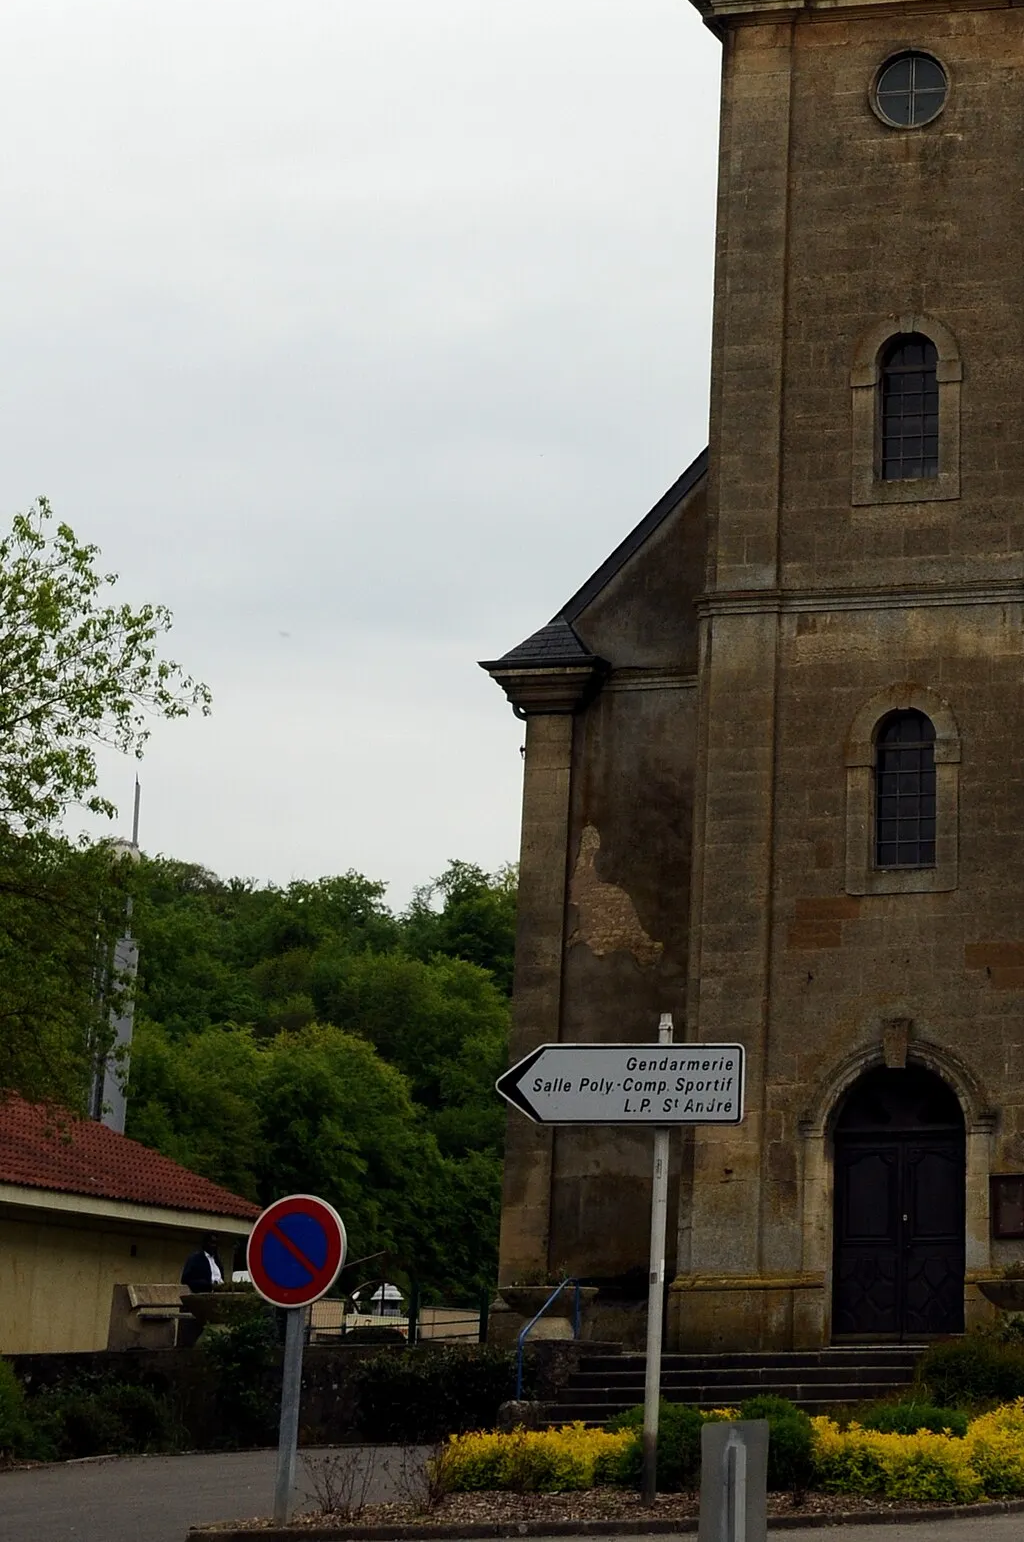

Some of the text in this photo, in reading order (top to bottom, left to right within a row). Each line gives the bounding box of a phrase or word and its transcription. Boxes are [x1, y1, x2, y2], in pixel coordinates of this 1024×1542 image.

[626, 1057, 734, 1072] Gendarmerie
[533, 1078, 572, 1093] Salle
[675, 1077, 734, 1095] Sportif
[624, 1098, 733, 1113] L.P. St André
